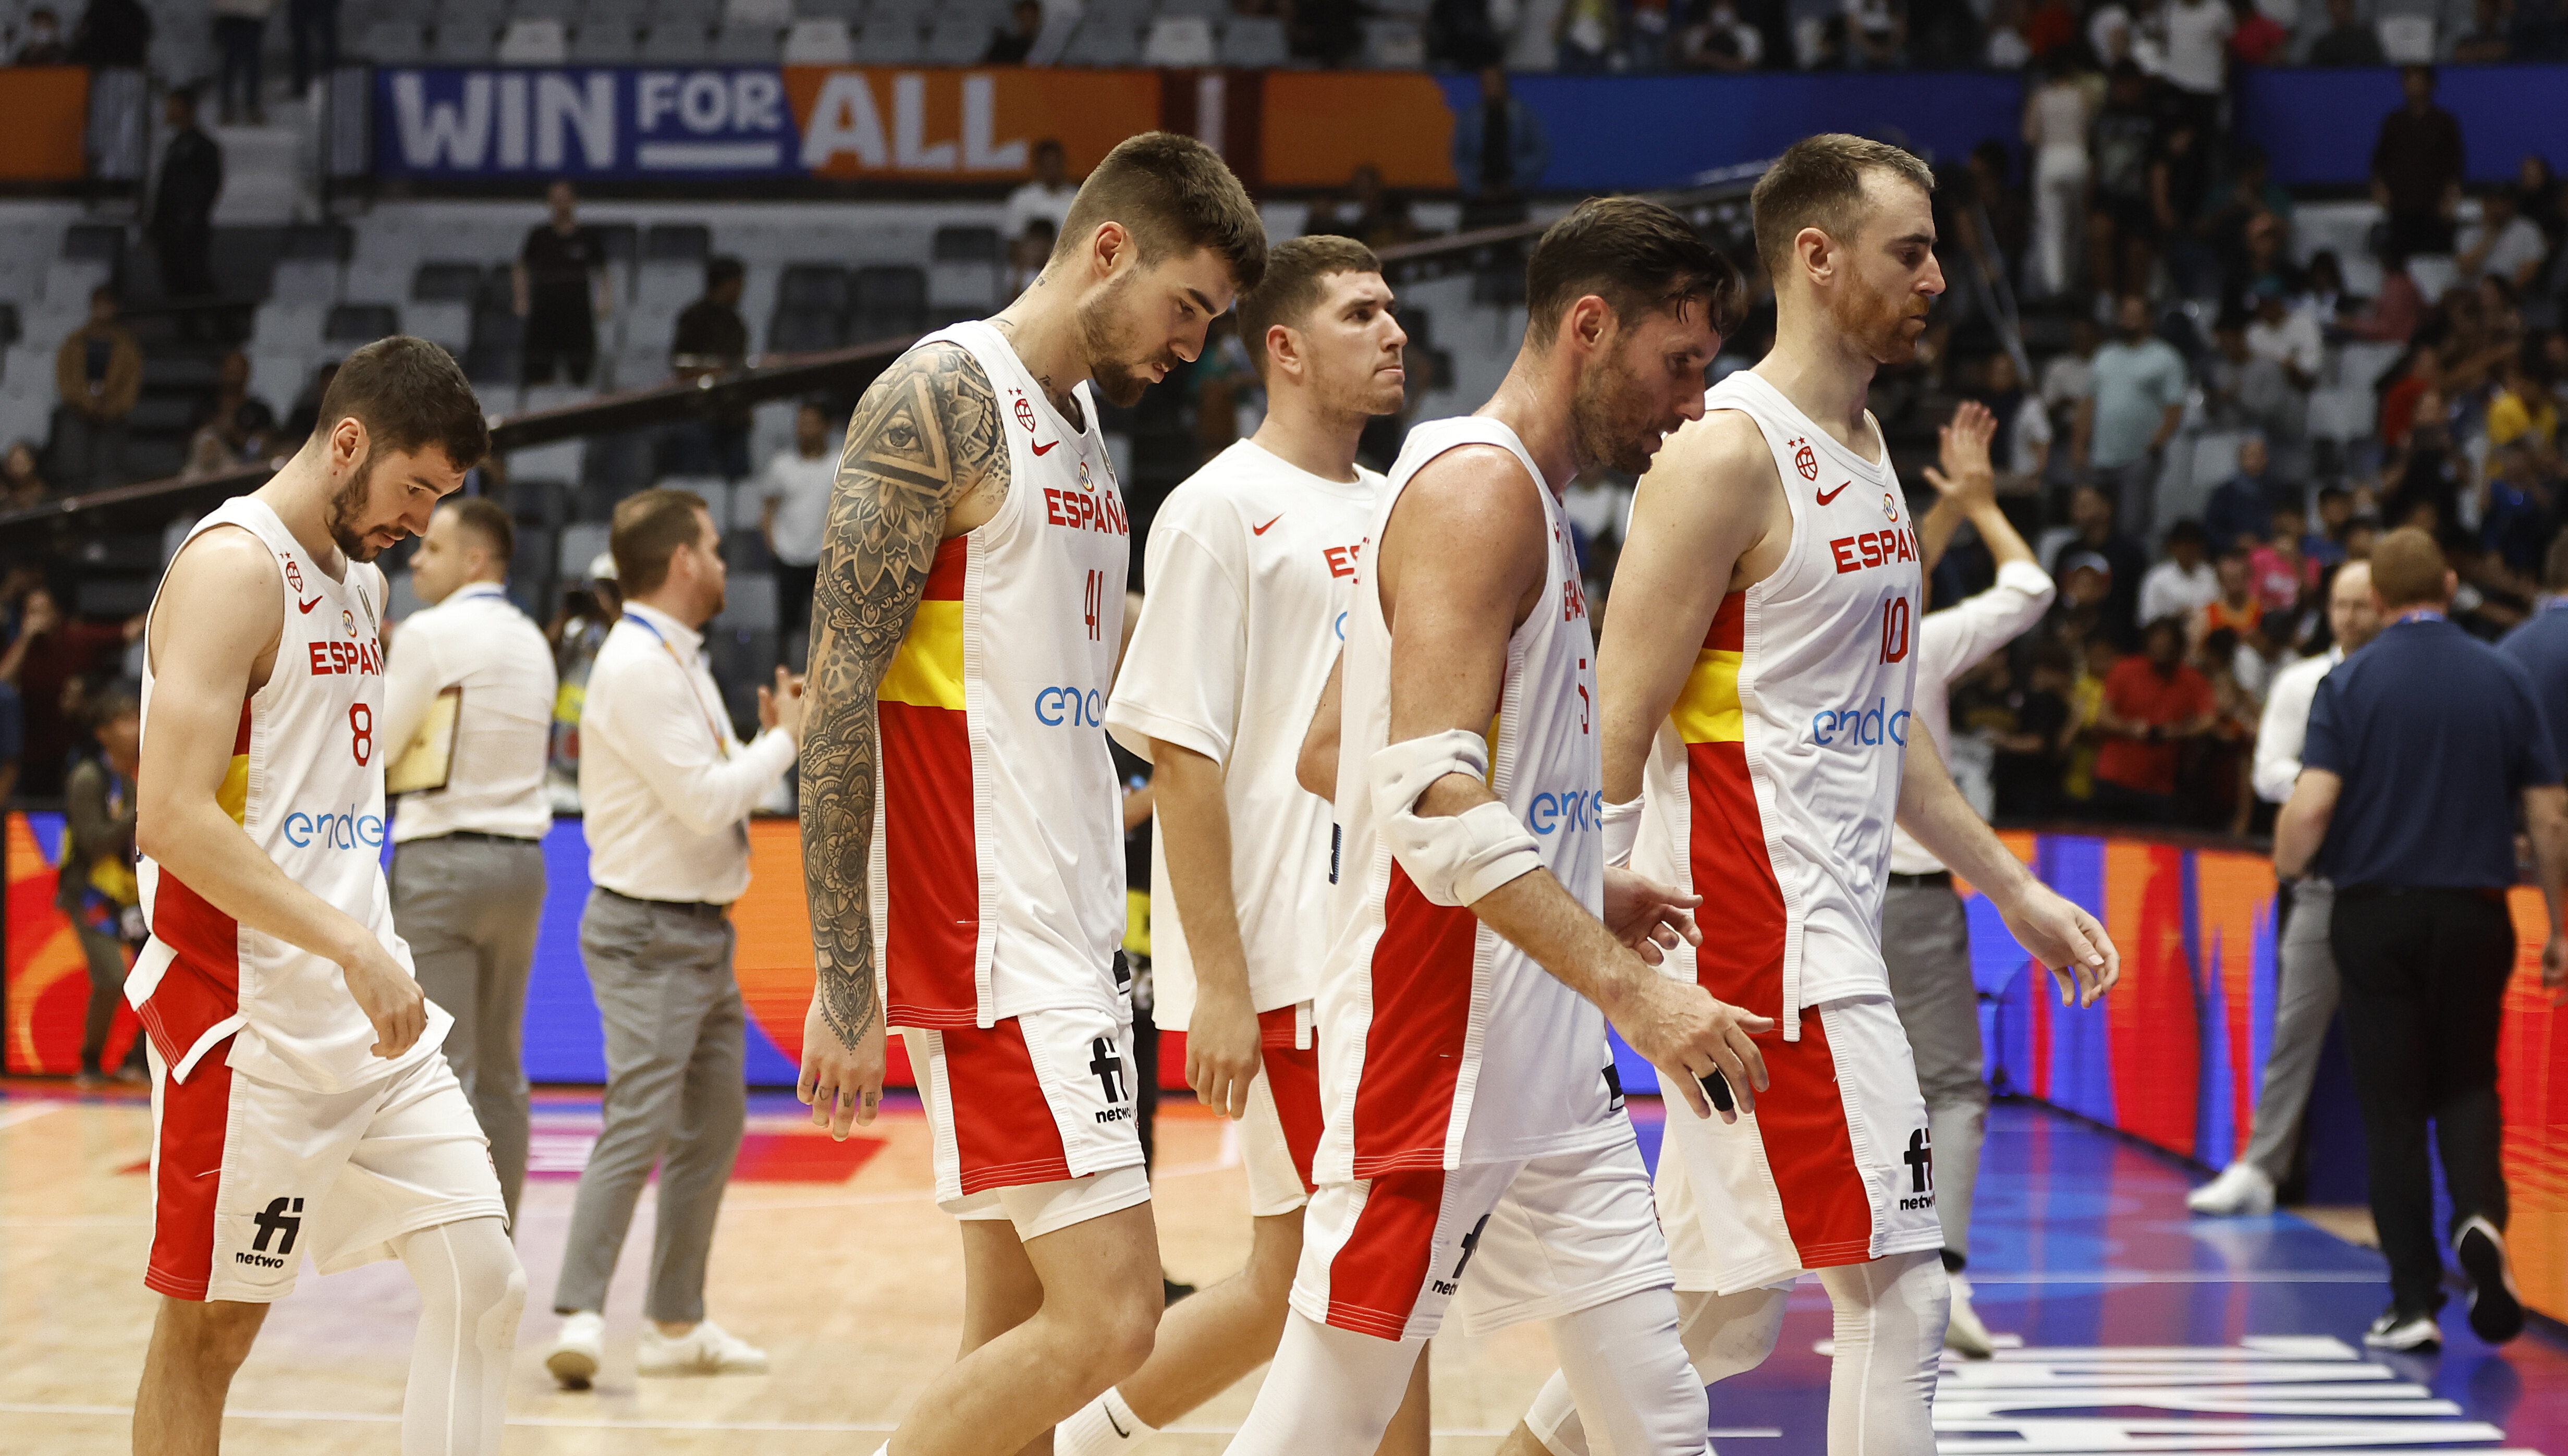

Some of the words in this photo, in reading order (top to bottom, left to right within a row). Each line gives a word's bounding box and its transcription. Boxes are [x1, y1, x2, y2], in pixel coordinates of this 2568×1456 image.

[390, 71, 617, 170] WIN
[635, 72, 781, 132] FOR
[799, 71, 1027, 170] ALL
[1085, 569, 1103, 641] 41
[1879, 596, 1909, 665] 10
[349, 703, 372, 766] 8
[1095, 1106, 1137, 1123] netwo
[253, 1197, 304, 1254] fi
[236, 1252, 284, 1269] netwo
